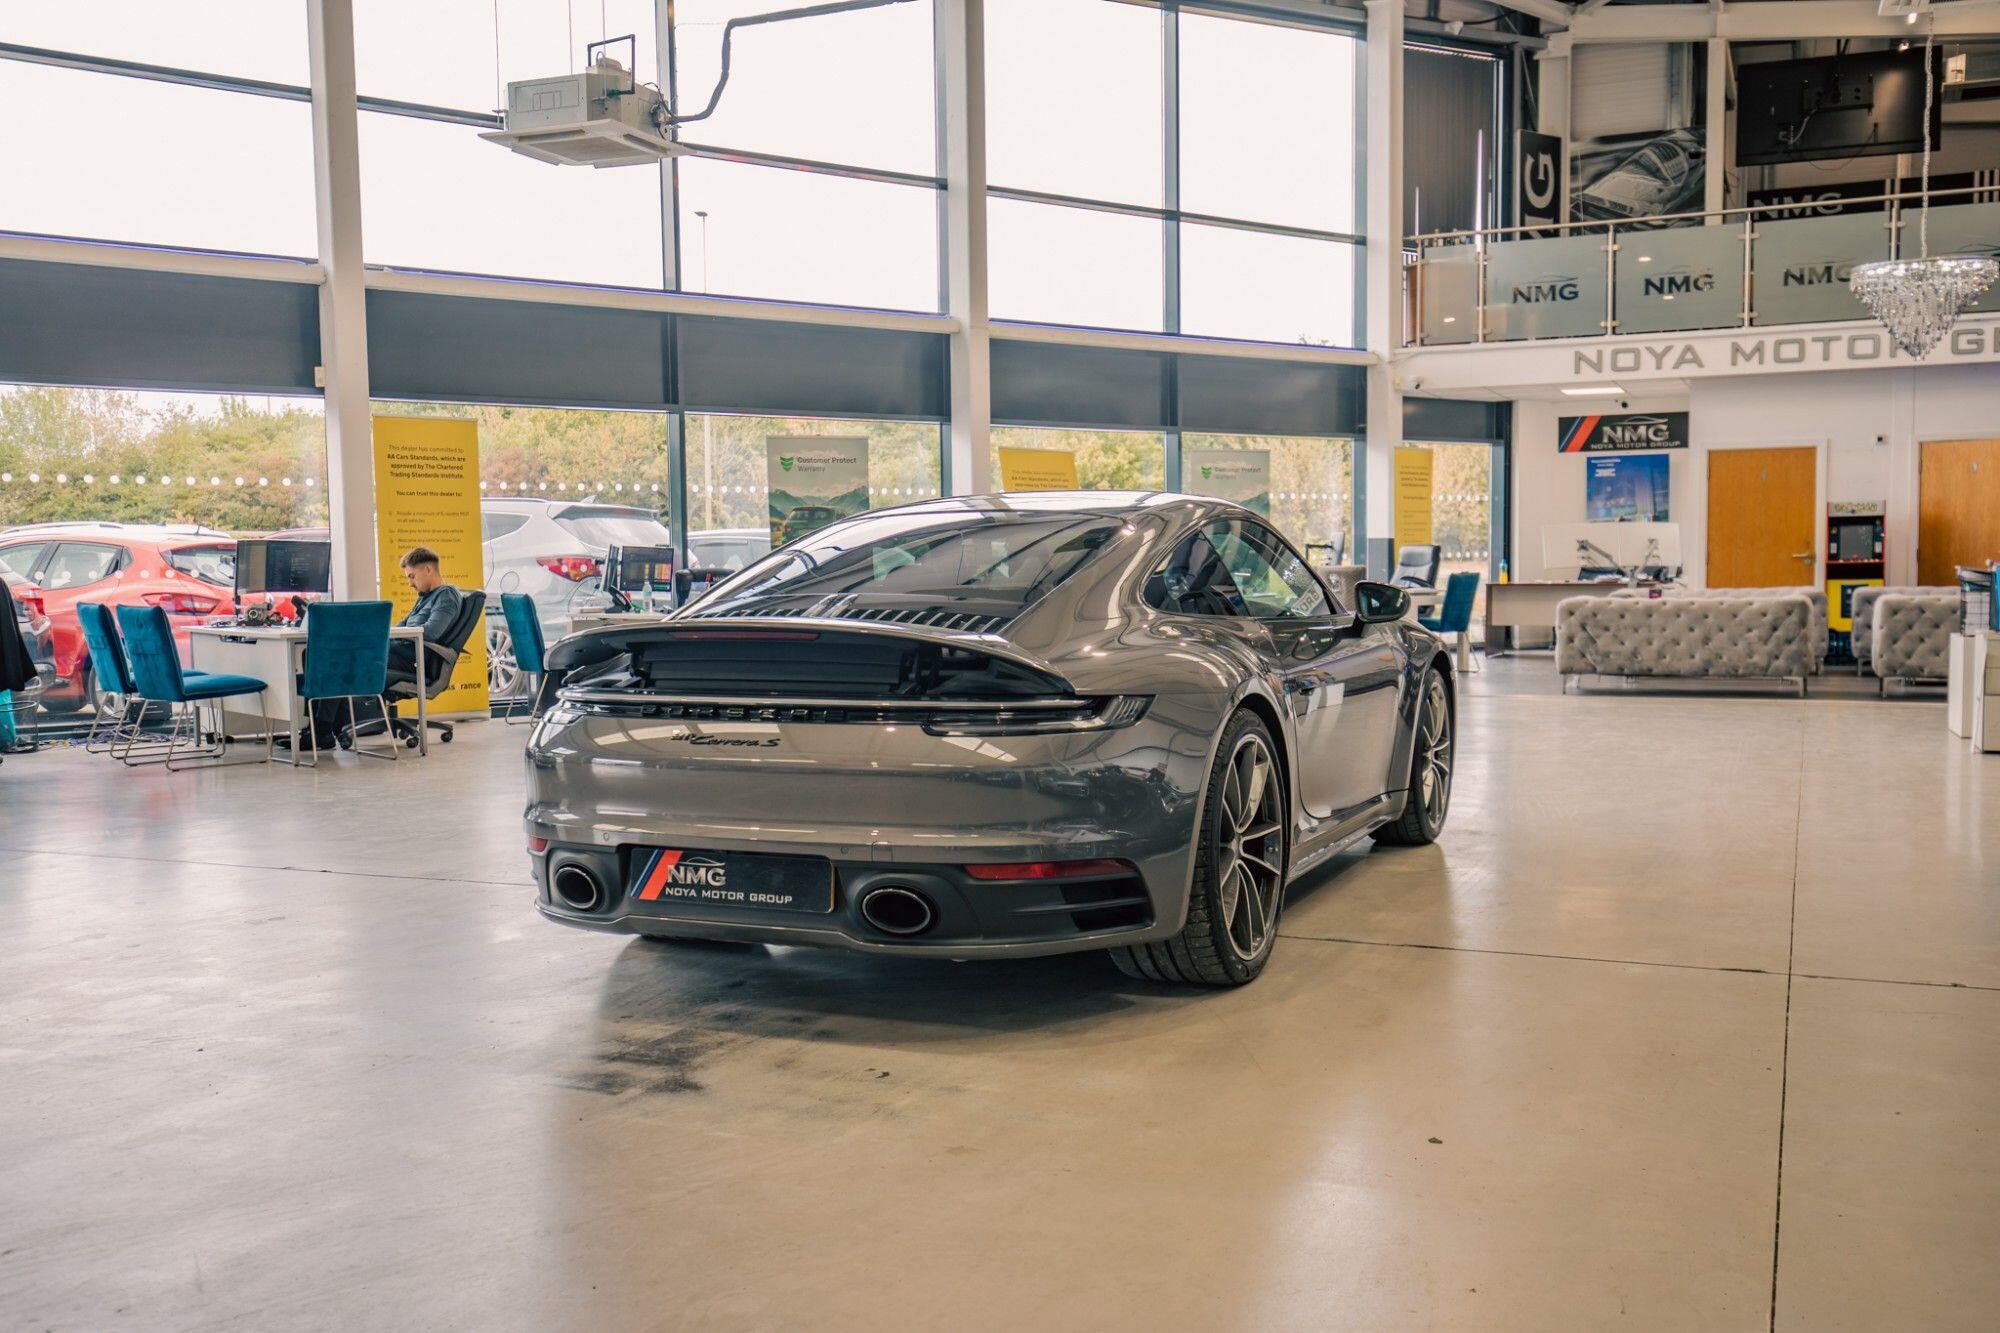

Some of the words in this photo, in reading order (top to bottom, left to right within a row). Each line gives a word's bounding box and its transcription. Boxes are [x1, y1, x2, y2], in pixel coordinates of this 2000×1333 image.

[1754, 192, 1843, 220] NMG
[1512, 283, 1579, 303] NMG
[1644, 273, 1714, 296] NMG
[1574, 343, 1705, 374] NOYA
[1952, 326, 2000, 355] G
[1601, 424, 1670, 443] NMG
[797, 456, 830, 464] Customer
[831, 456, 857, 464] Protect
[690, 735, 759, 746] Carrera
[760, 738, 780, 747] S
[667, 864, 726, 887] NMG
[665, 887, 697, 898] NOYA
[701, 889, 744, 901] MOTOR
[750, 893, 793, 905] GROUP
